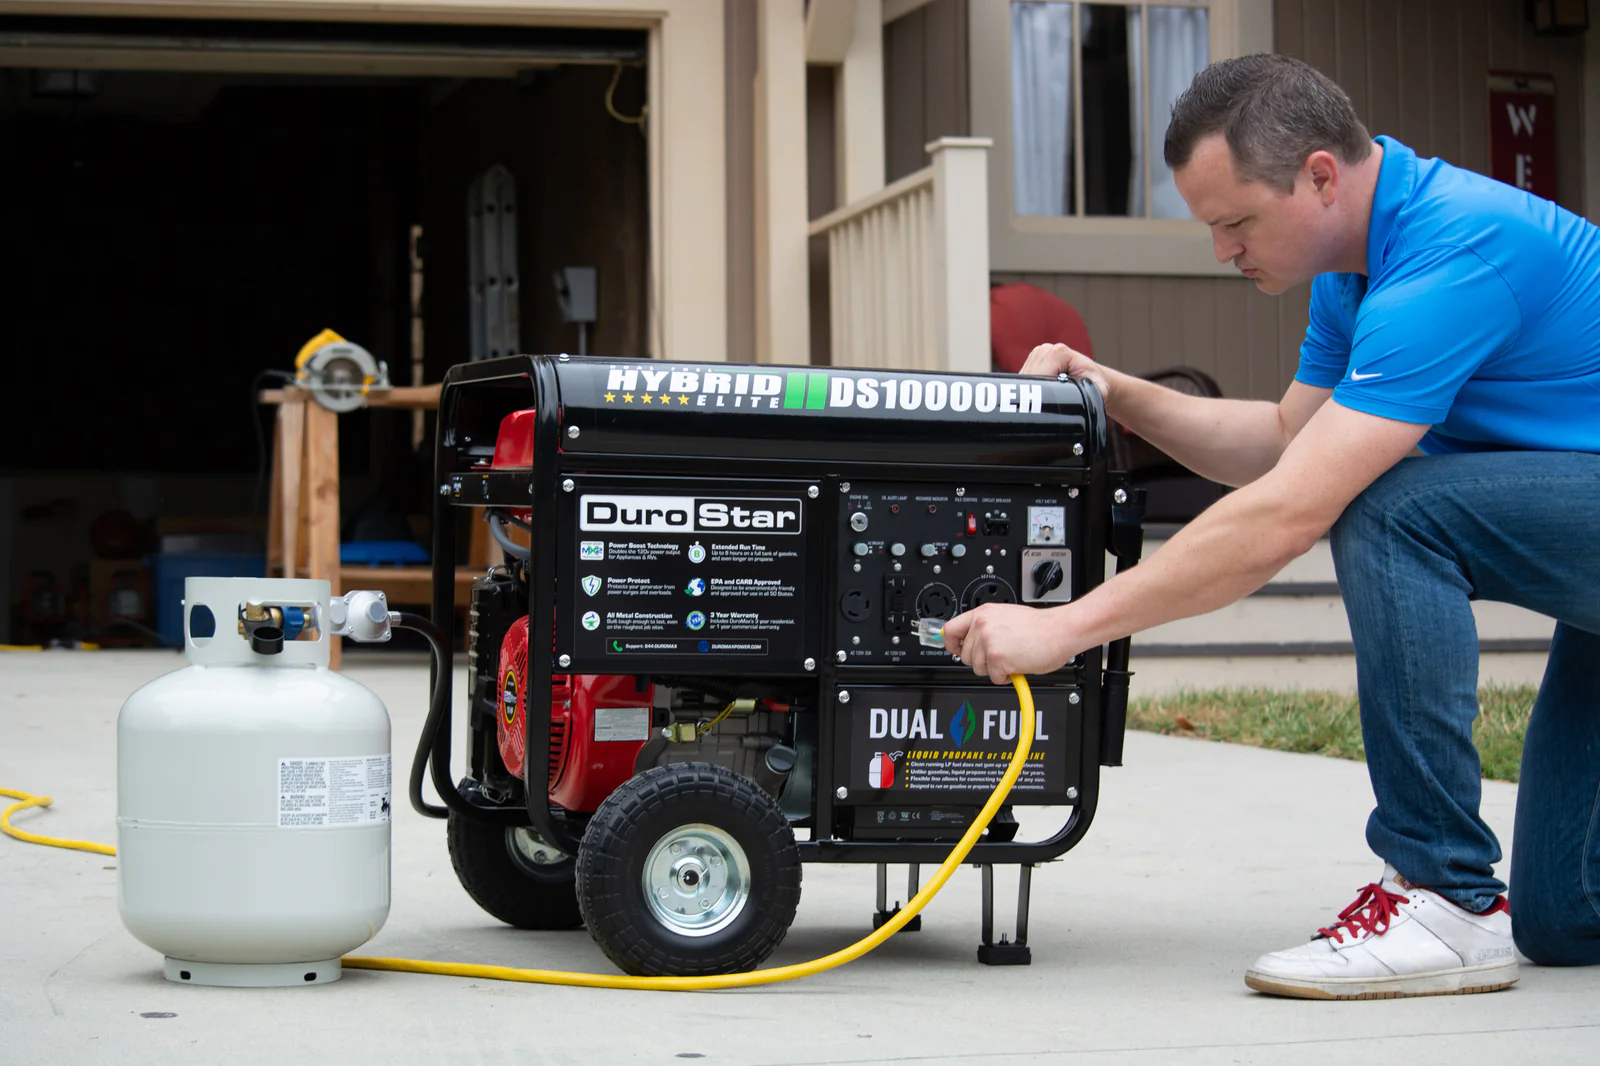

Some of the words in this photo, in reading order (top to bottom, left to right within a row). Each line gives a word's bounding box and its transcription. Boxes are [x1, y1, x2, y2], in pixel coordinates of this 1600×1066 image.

[607, 370, 782, 395] HYBRID
[830, 377, 1042, 413] DS10000EH
[696, 394, 779, 409] ELITE
[870, 708, 944, 739] DUAL
[907, 751, 939, 760] LIQUID
[942, 751, 984, 760] PROPANE
